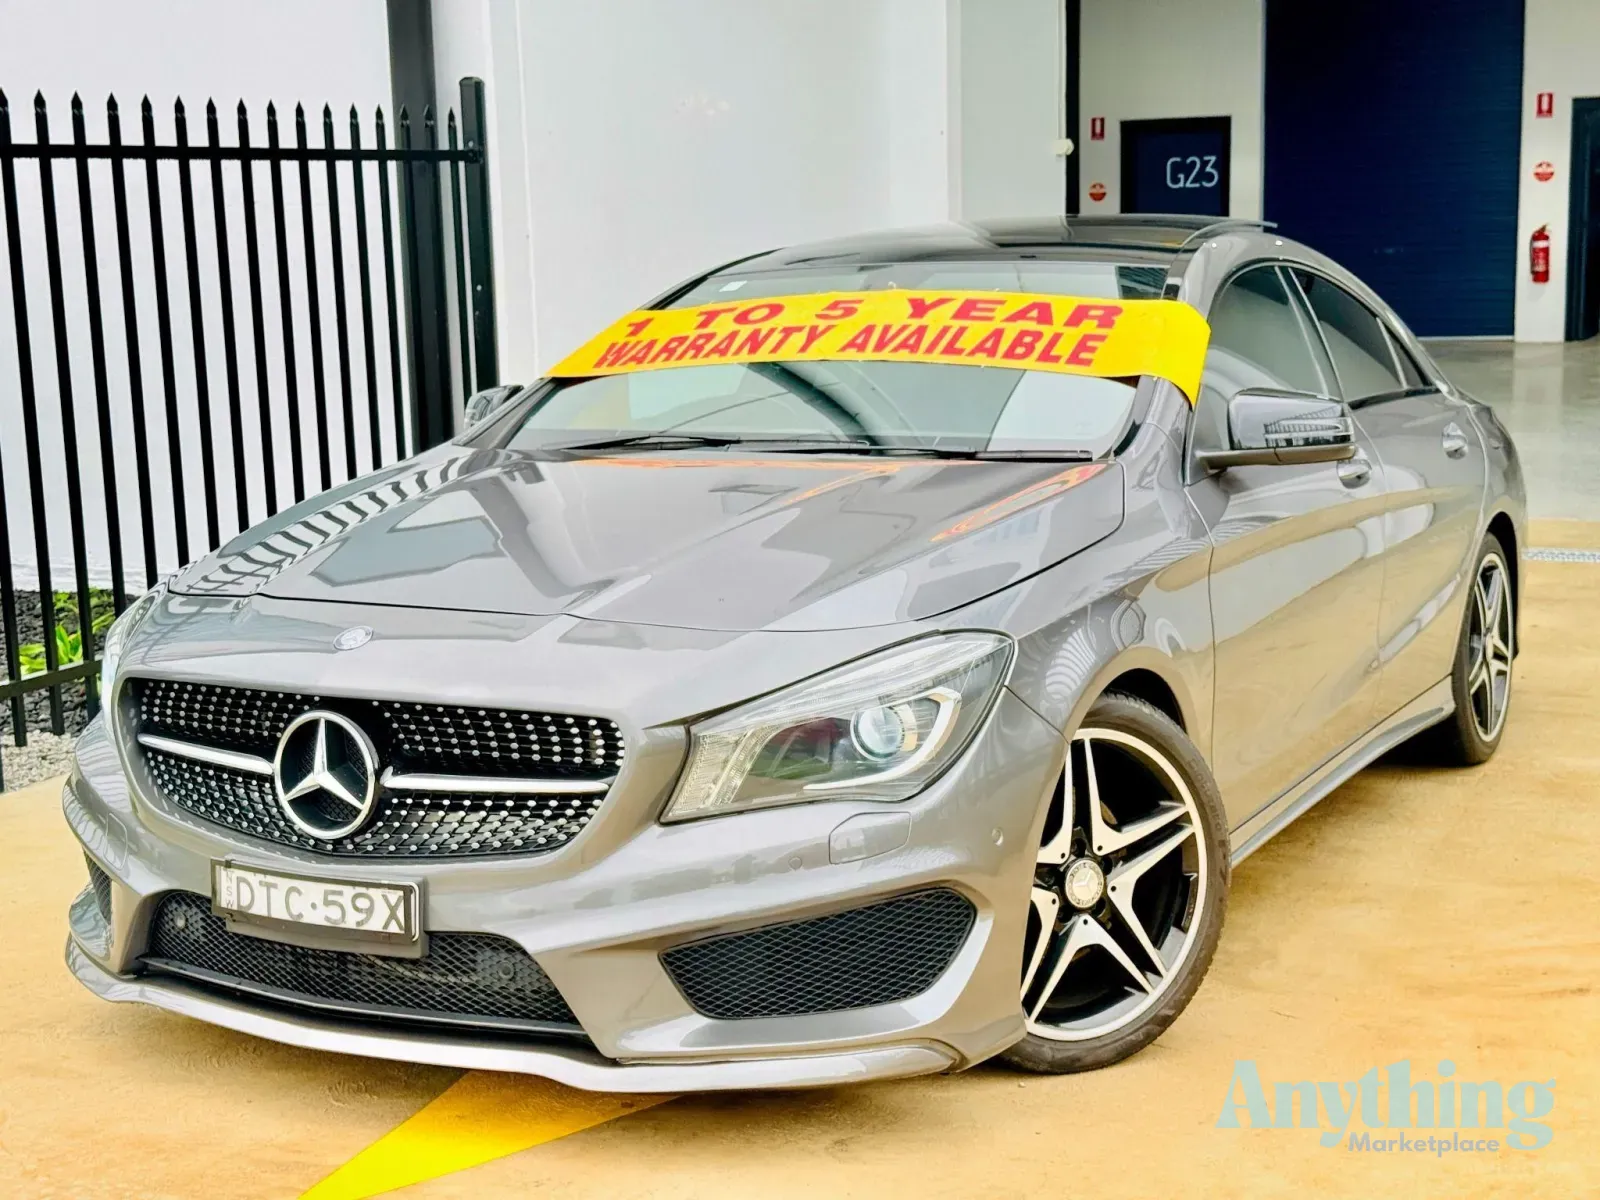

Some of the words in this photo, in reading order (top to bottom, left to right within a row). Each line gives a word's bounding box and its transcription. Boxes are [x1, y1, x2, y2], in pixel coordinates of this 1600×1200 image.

[1166, 155, 1219, 188] G23
[626, 317, 655, 338] 1
[694, 302, 786, 331] TO
[815, 299, 865, 321] 5
[906, 298, 1124, 329] YEAR
[592, 324, 838, 369] WARRANTY
[837, 324, 1108, 367] AVAILABLE
